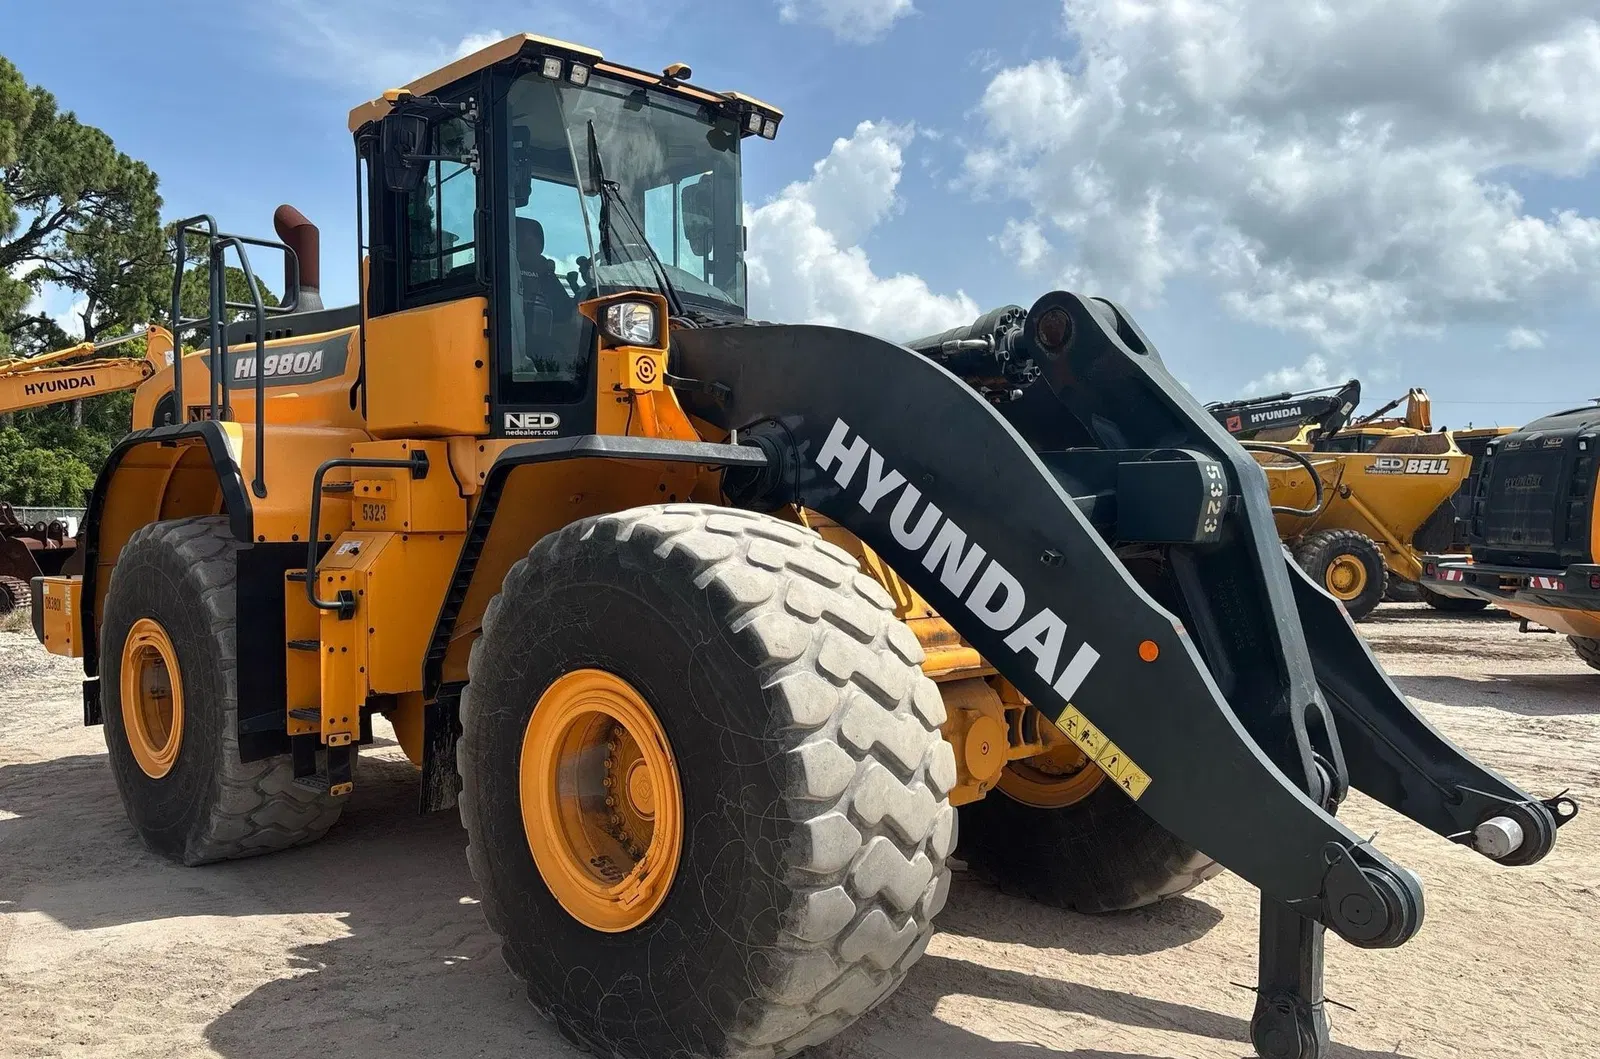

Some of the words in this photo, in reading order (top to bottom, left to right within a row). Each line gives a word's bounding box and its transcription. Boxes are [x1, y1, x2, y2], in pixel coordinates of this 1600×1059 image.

[24, 375, 96, 396] HYUNDAI
[504, 413, 560, 429] NED
[1251, 406, 1302, 423] HYUNDAI
[1404, 459, 1449, 475] BELL
[1204, 465, 1223, 534] 5323
[362, 504, 386, 521] 5323
[815, 417, 1101, 702] HYUNDAI
